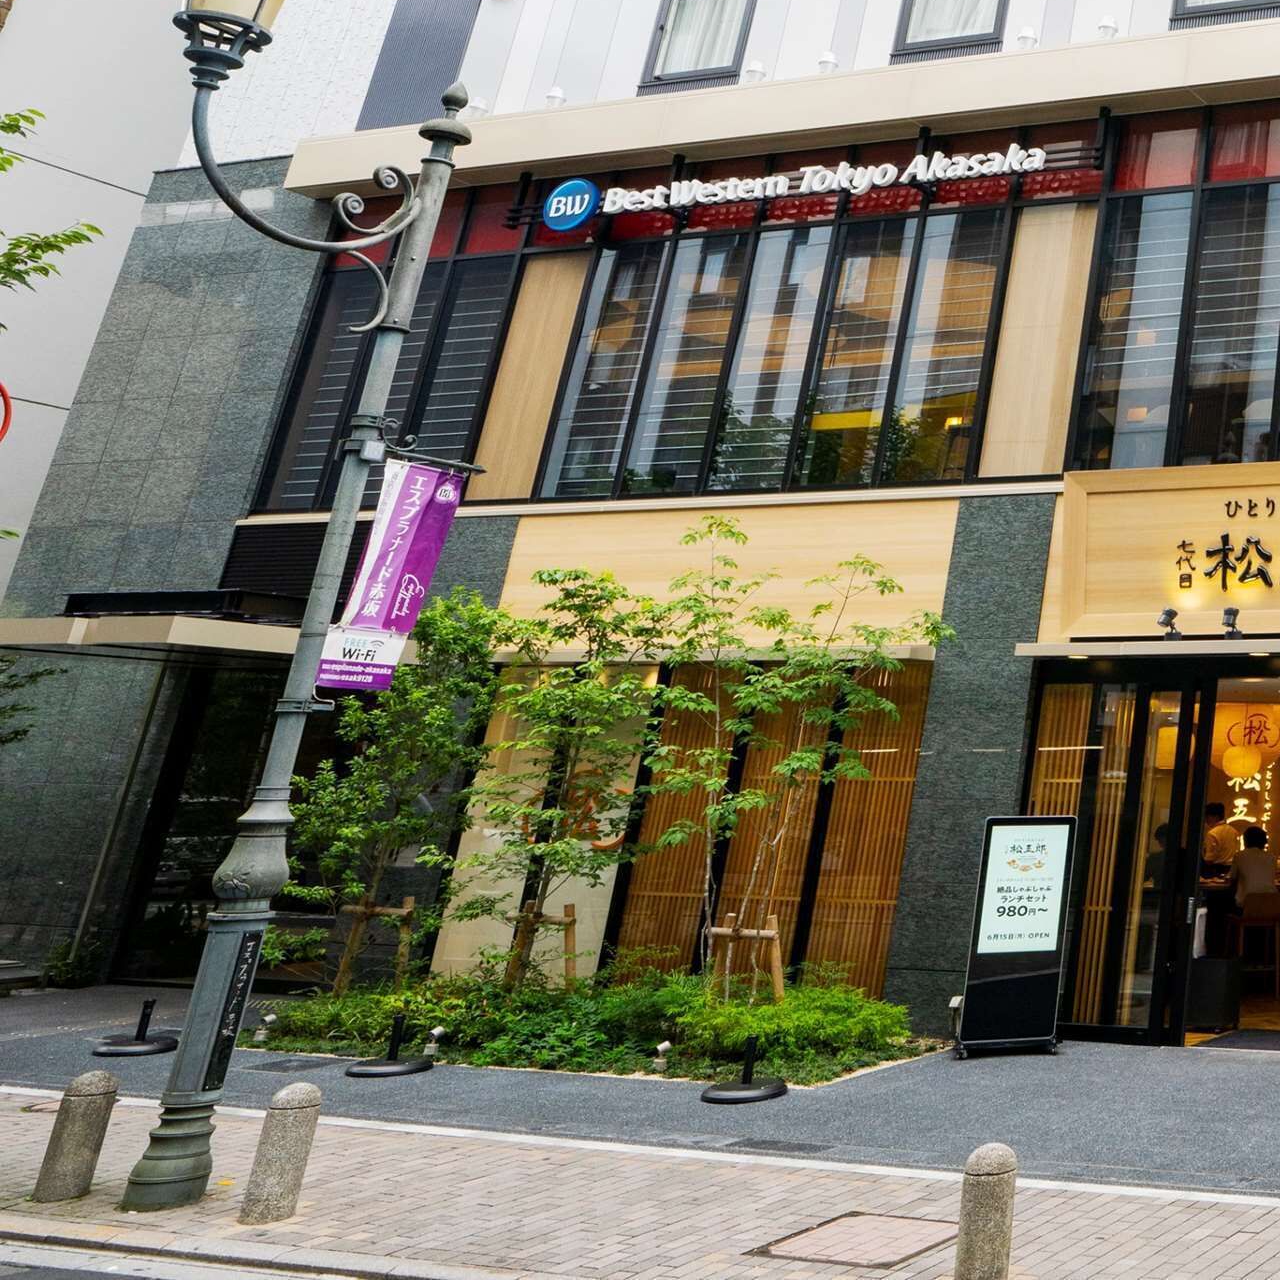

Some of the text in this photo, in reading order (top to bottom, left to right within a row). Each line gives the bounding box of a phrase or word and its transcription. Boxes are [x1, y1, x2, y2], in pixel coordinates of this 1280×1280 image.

[603, 143, 1046, 214] Best Western Tokyo Akasaka
[549, 194, 590, 218] BW
[1175, 540, 1197, 589] 七代目
[342, 647, 377, 661] Wi-Fi
[1244, 720, 1270, 745] 松
